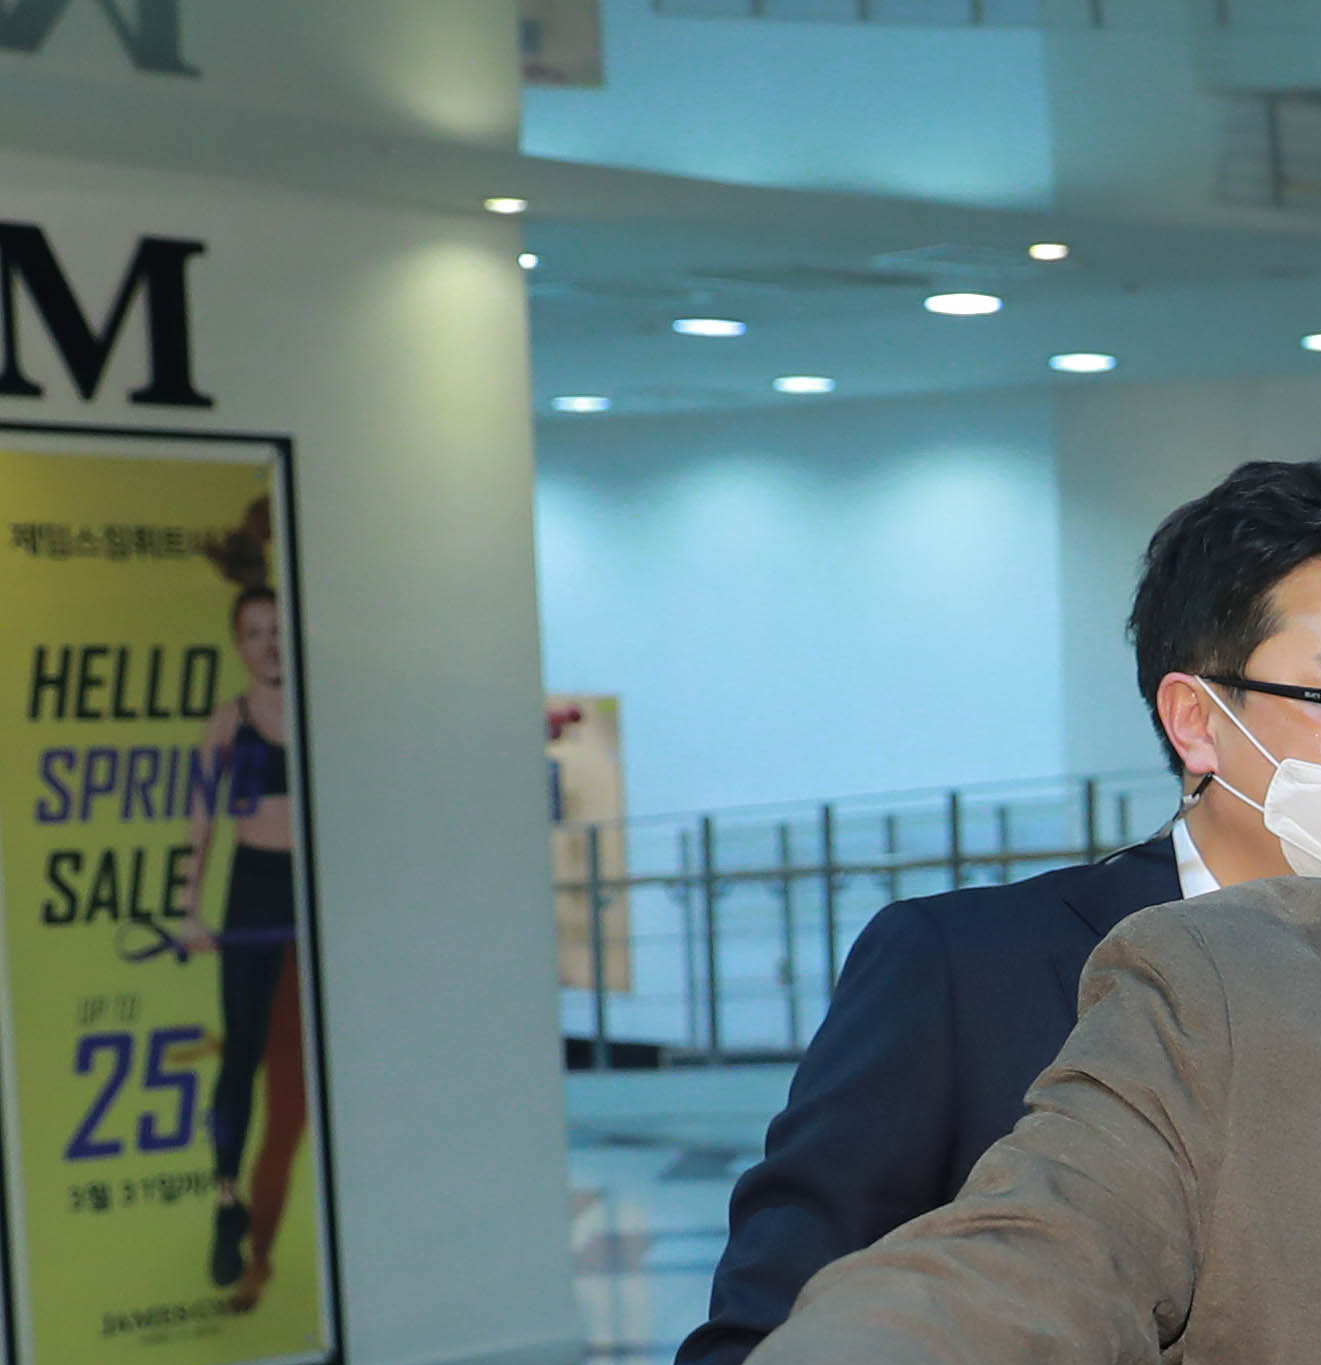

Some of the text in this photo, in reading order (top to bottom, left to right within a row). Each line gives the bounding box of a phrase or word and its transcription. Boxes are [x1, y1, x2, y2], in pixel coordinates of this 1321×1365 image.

[0, 221, 213, 408] M
[28, 644, 220, 721] HELLO
[35, 744, 266, 825] SPRING
[41, 845, 195, 925] SALE
